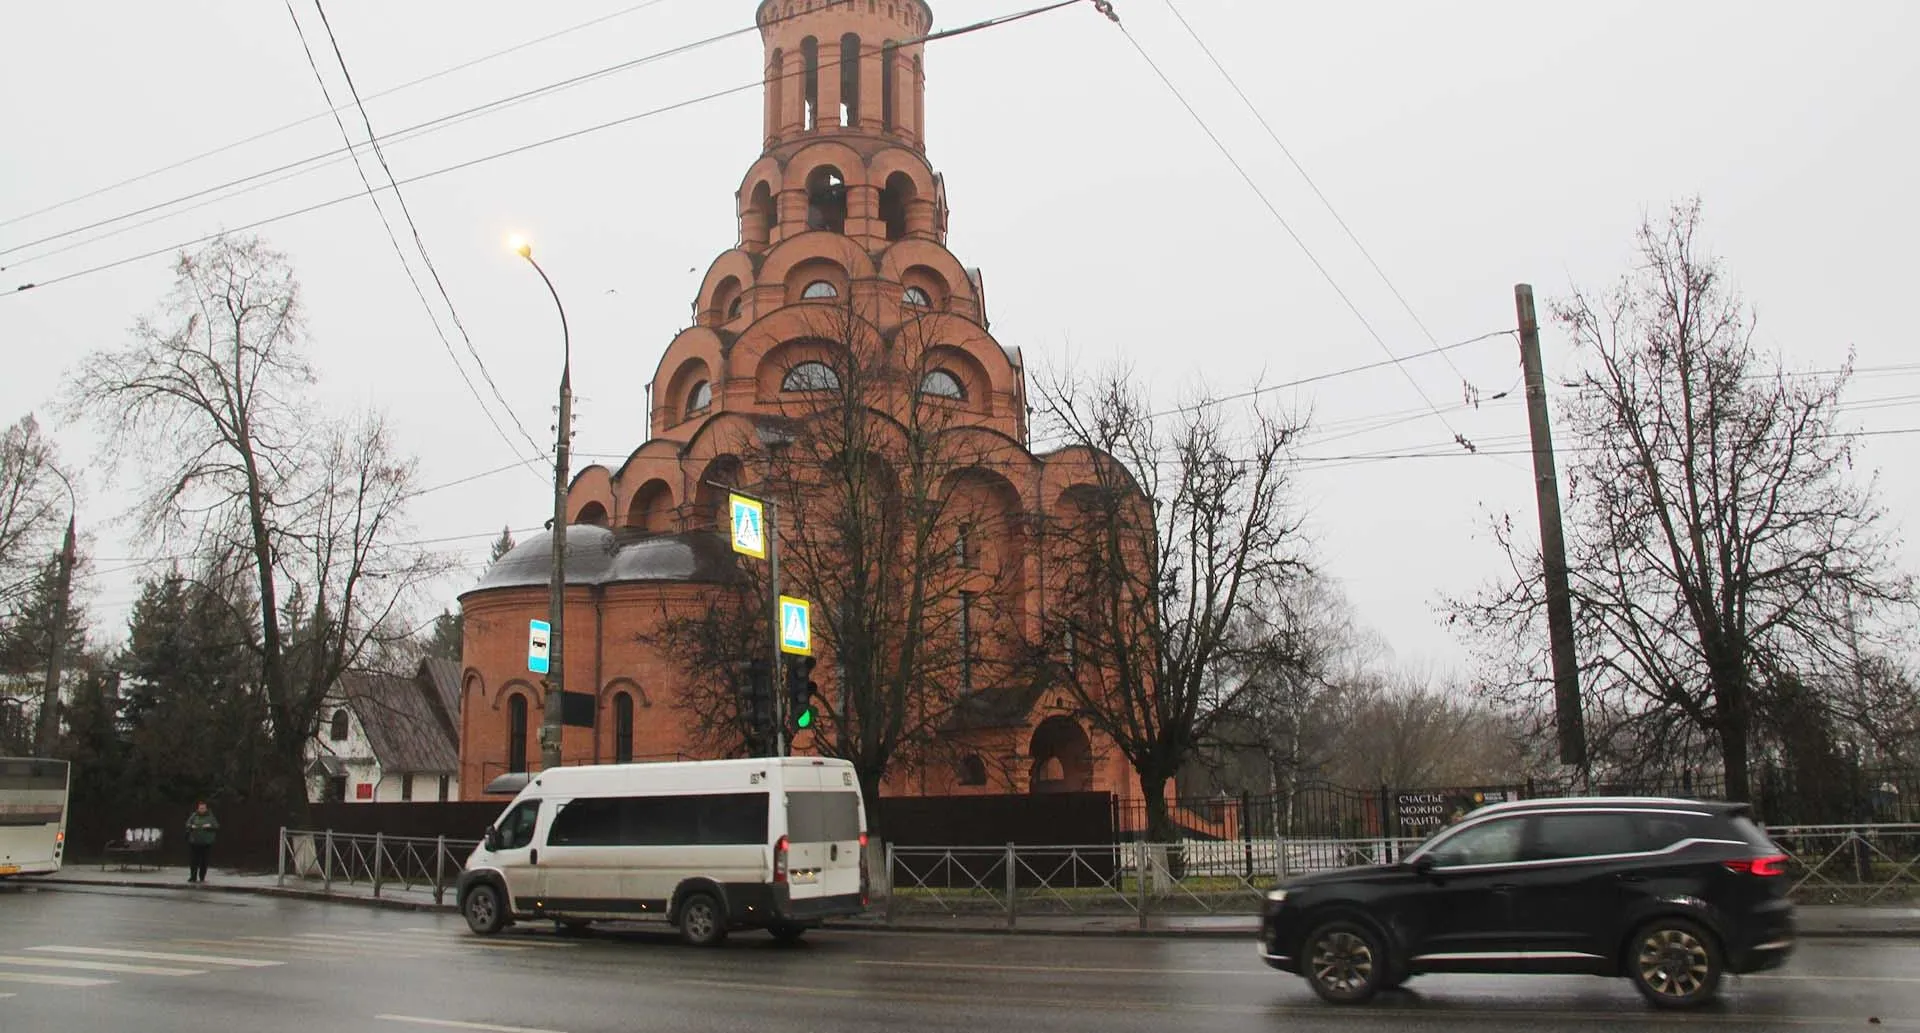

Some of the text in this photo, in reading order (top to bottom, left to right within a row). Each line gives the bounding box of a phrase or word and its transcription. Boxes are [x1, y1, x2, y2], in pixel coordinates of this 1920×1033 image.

[1399, 794, 1443, 804] СЧАСТЬЕ
[1399, 805, 1443, 814] МОЖНО
[1400, 816, 1441, 825] РОДИТЬ
